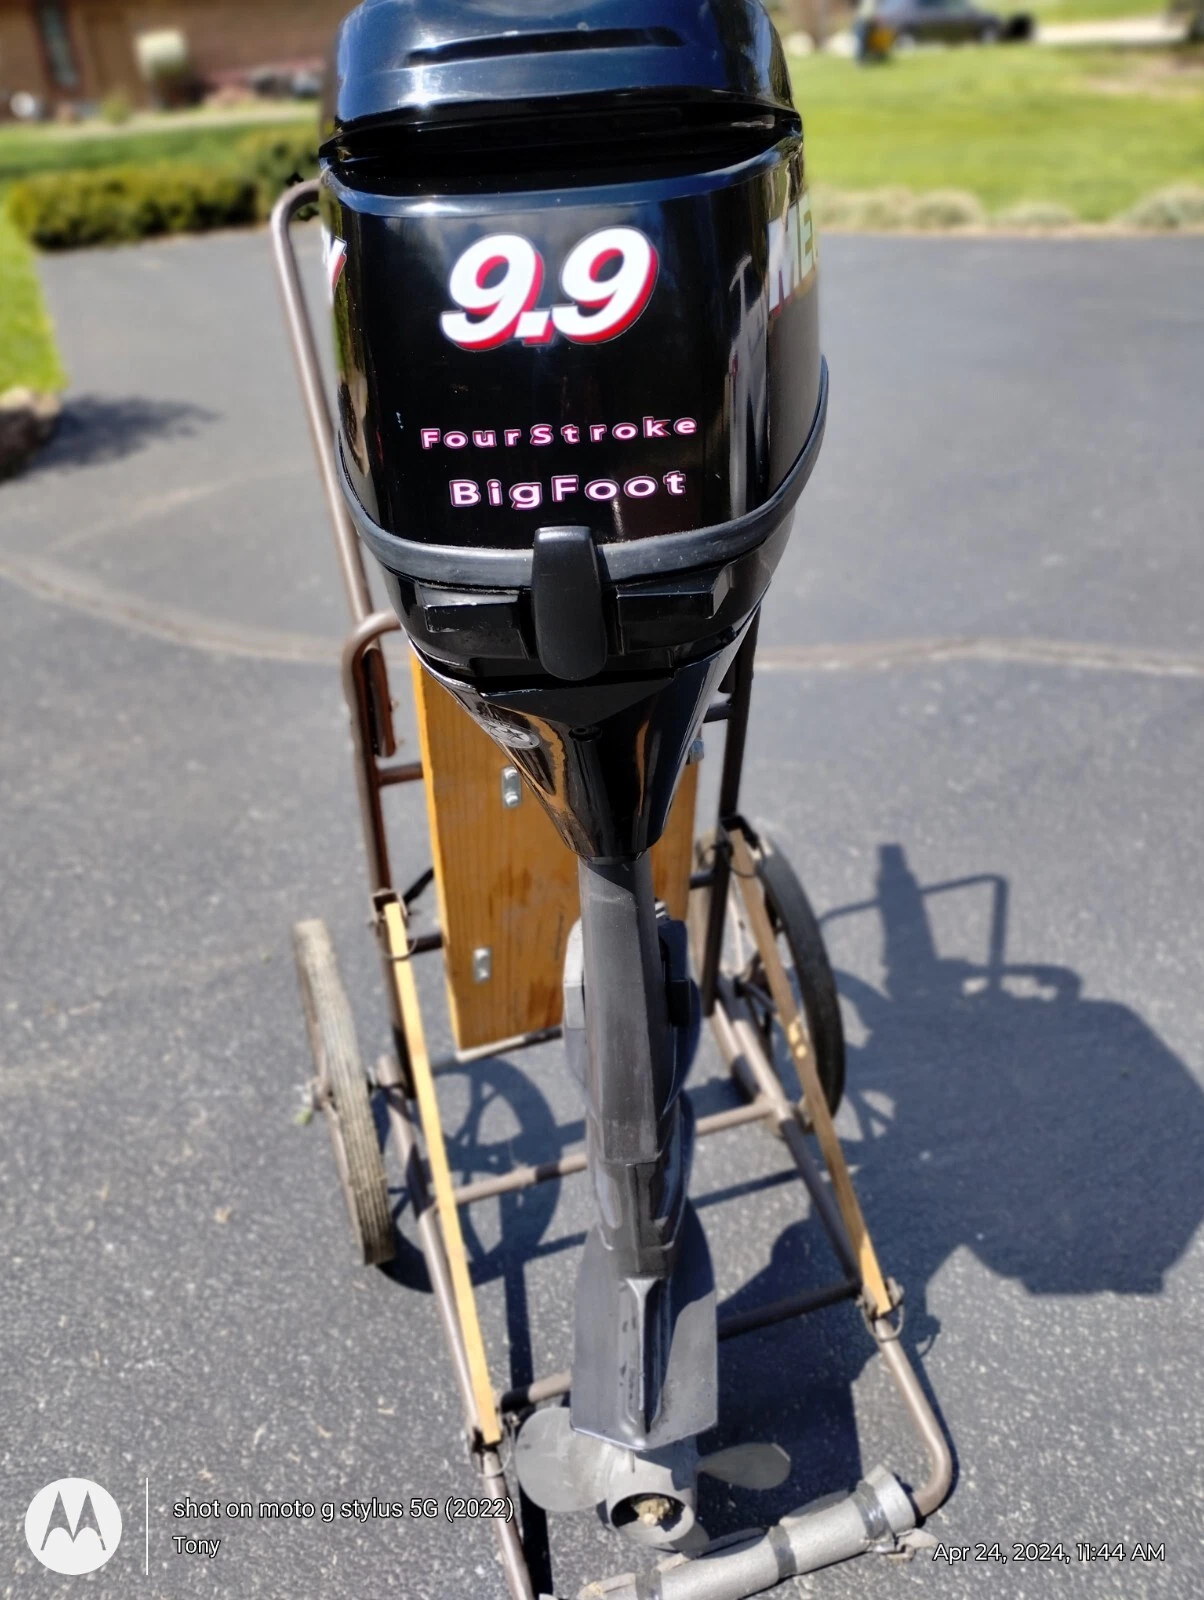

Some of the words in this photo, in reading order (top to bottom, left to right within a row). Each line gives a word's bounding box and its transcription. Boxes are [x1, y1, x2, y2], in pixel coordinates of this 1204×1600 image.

[439, 225, 660, 351] 9.9
[767, 193, 818, 315] ME
[420, 416, 698, 450] FourStroke
[449, 470, 686, 510] BigFoot
